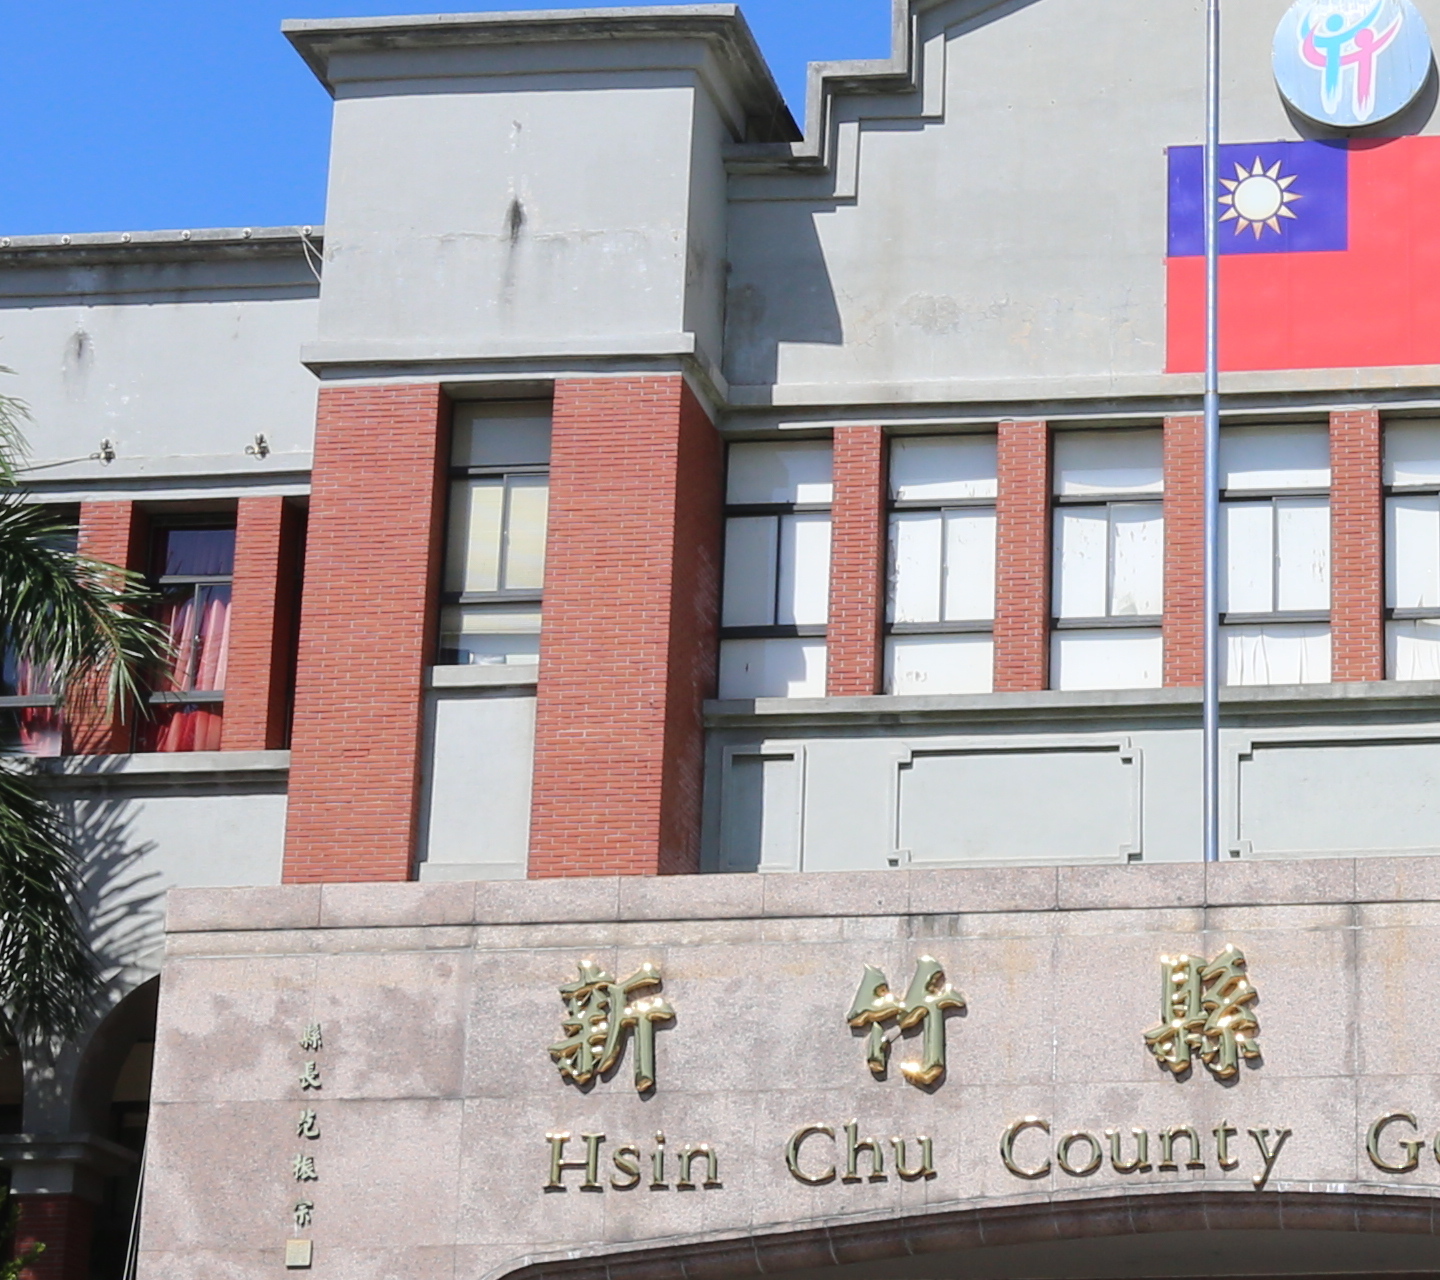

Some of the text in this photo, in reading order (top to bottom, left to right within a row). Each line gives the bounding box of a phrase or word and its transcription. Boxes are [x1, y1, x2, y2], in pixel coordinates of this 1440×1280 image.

[543, 1129, 723, 1192] Hsin
[786, 1118, 937, 1185] Chu
[1000, 1114, 1292, 1189] County
